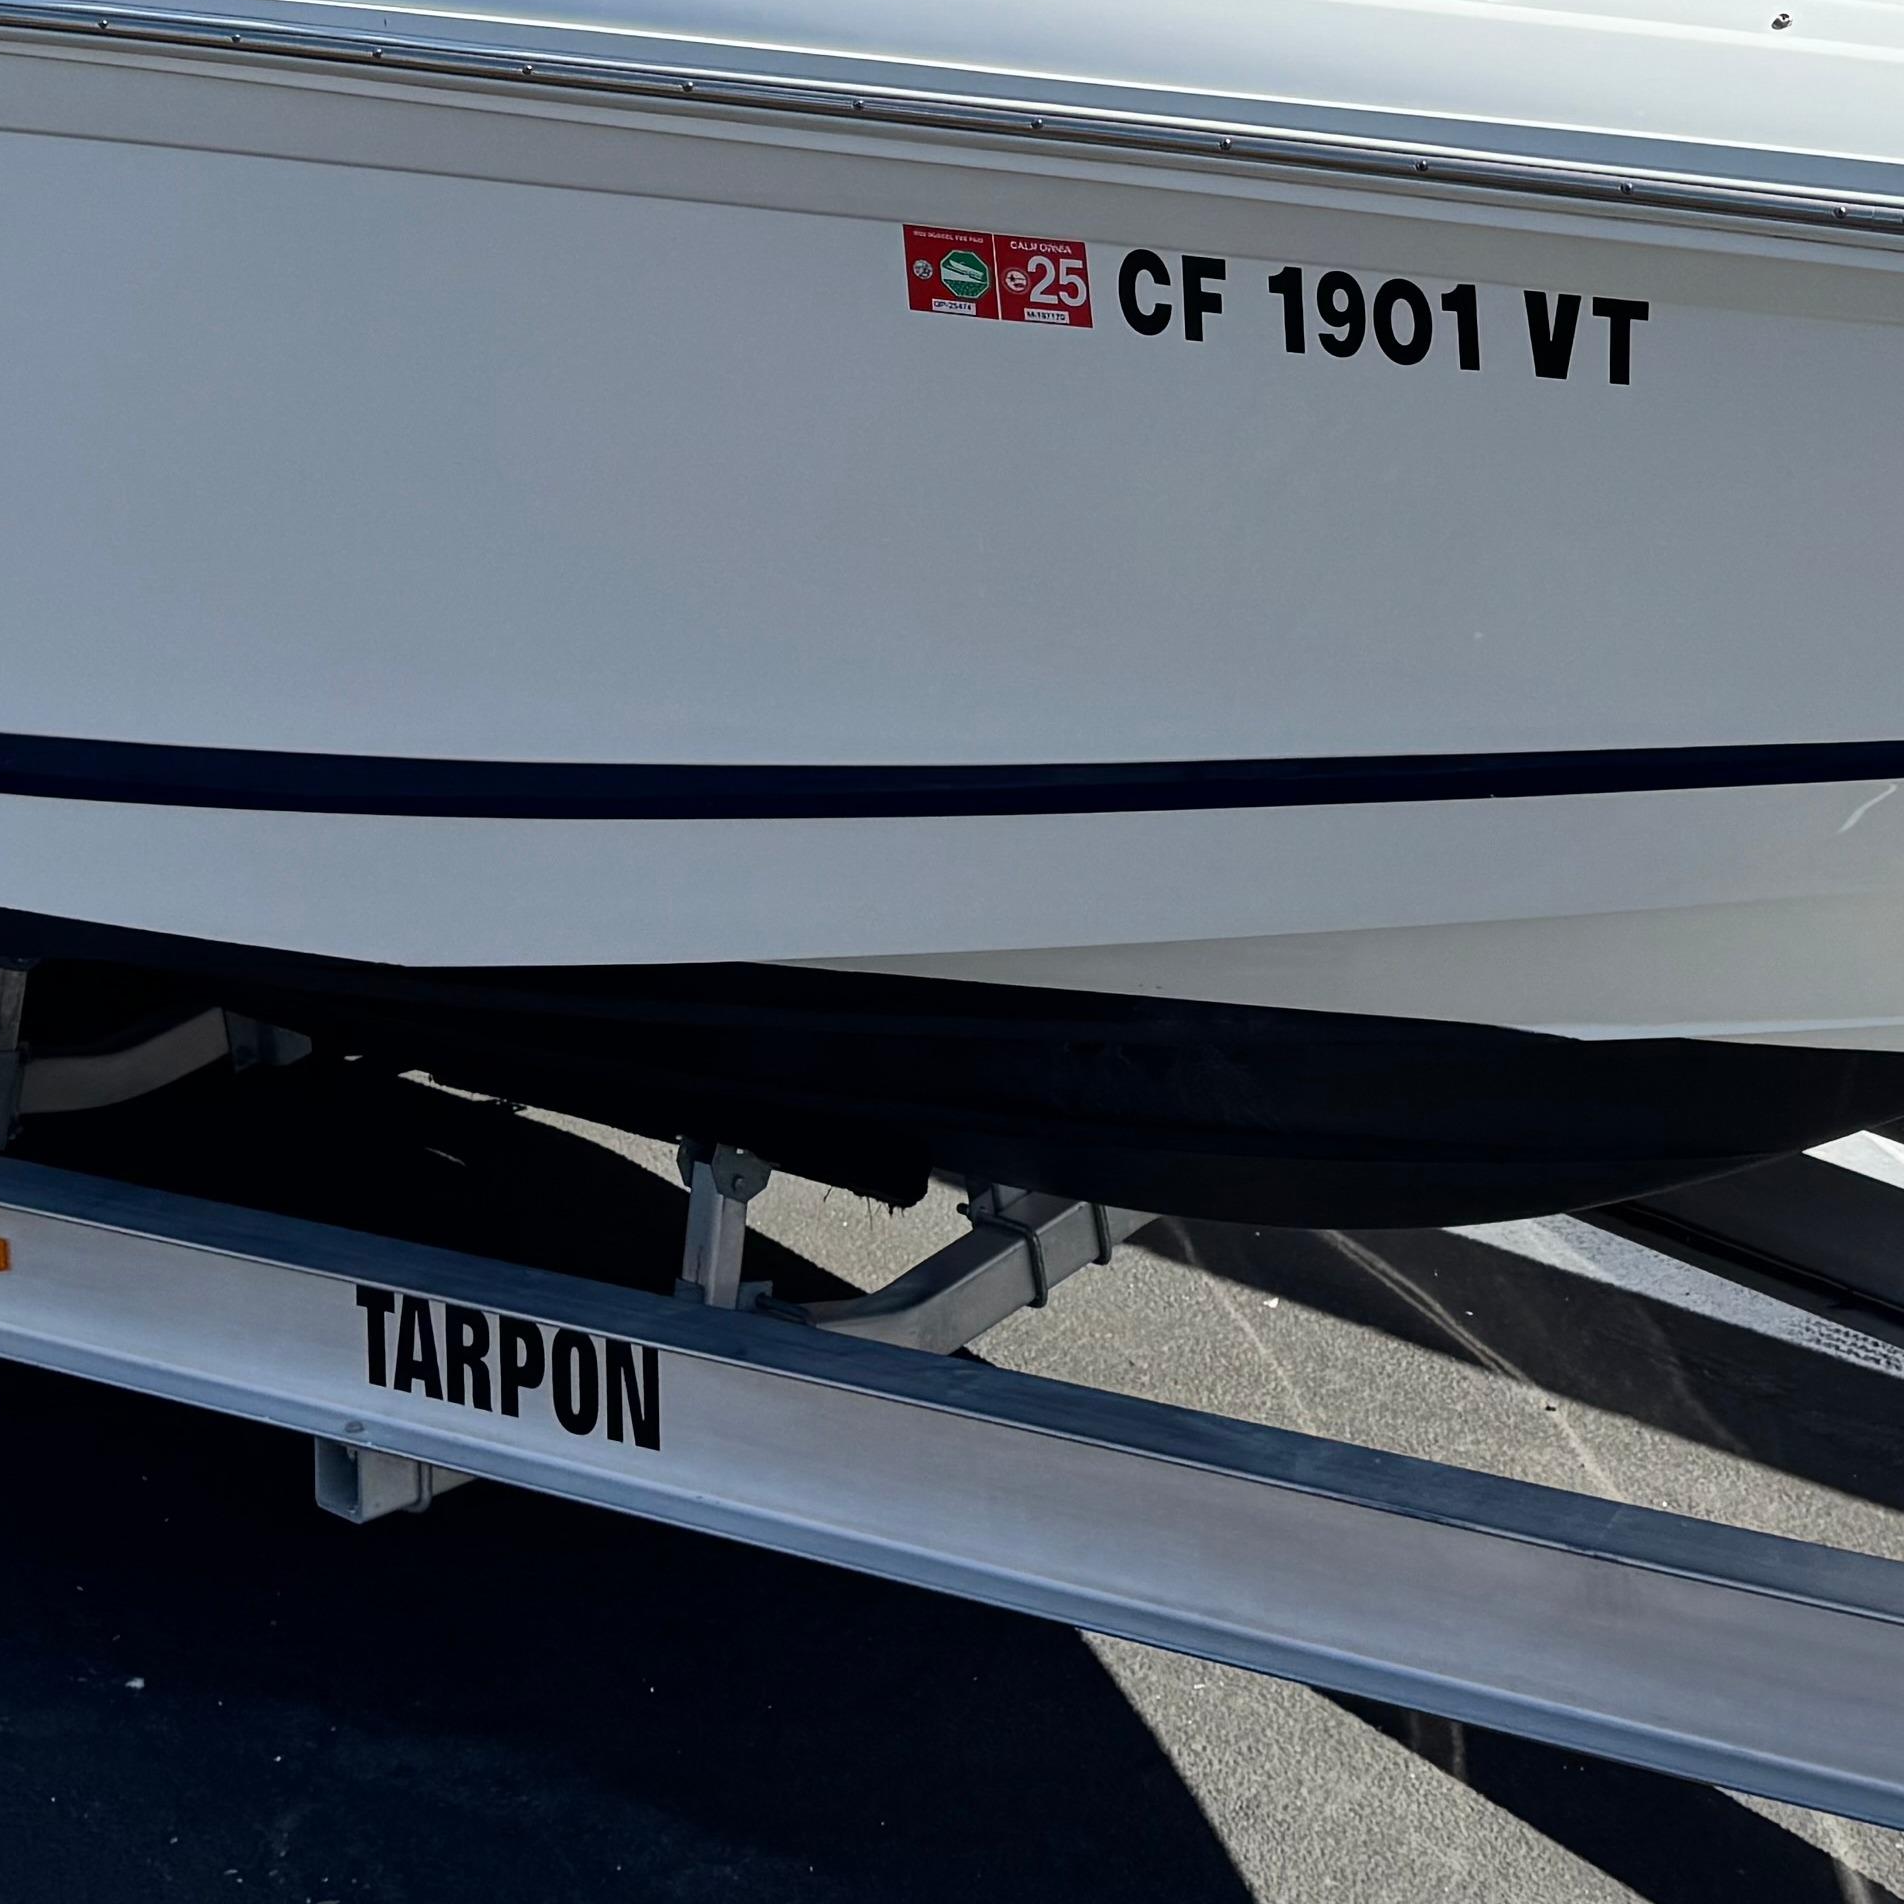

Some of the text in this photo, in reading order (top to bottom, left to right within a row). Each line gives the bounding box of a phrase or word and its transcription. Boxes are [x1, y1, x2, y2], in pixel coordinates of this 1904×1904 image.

[1027, 255, 1087, 307] 25
[1118, 249, 1649, 386] CF 1901 VT
[355, 1284, 661, 1452] TARPON
